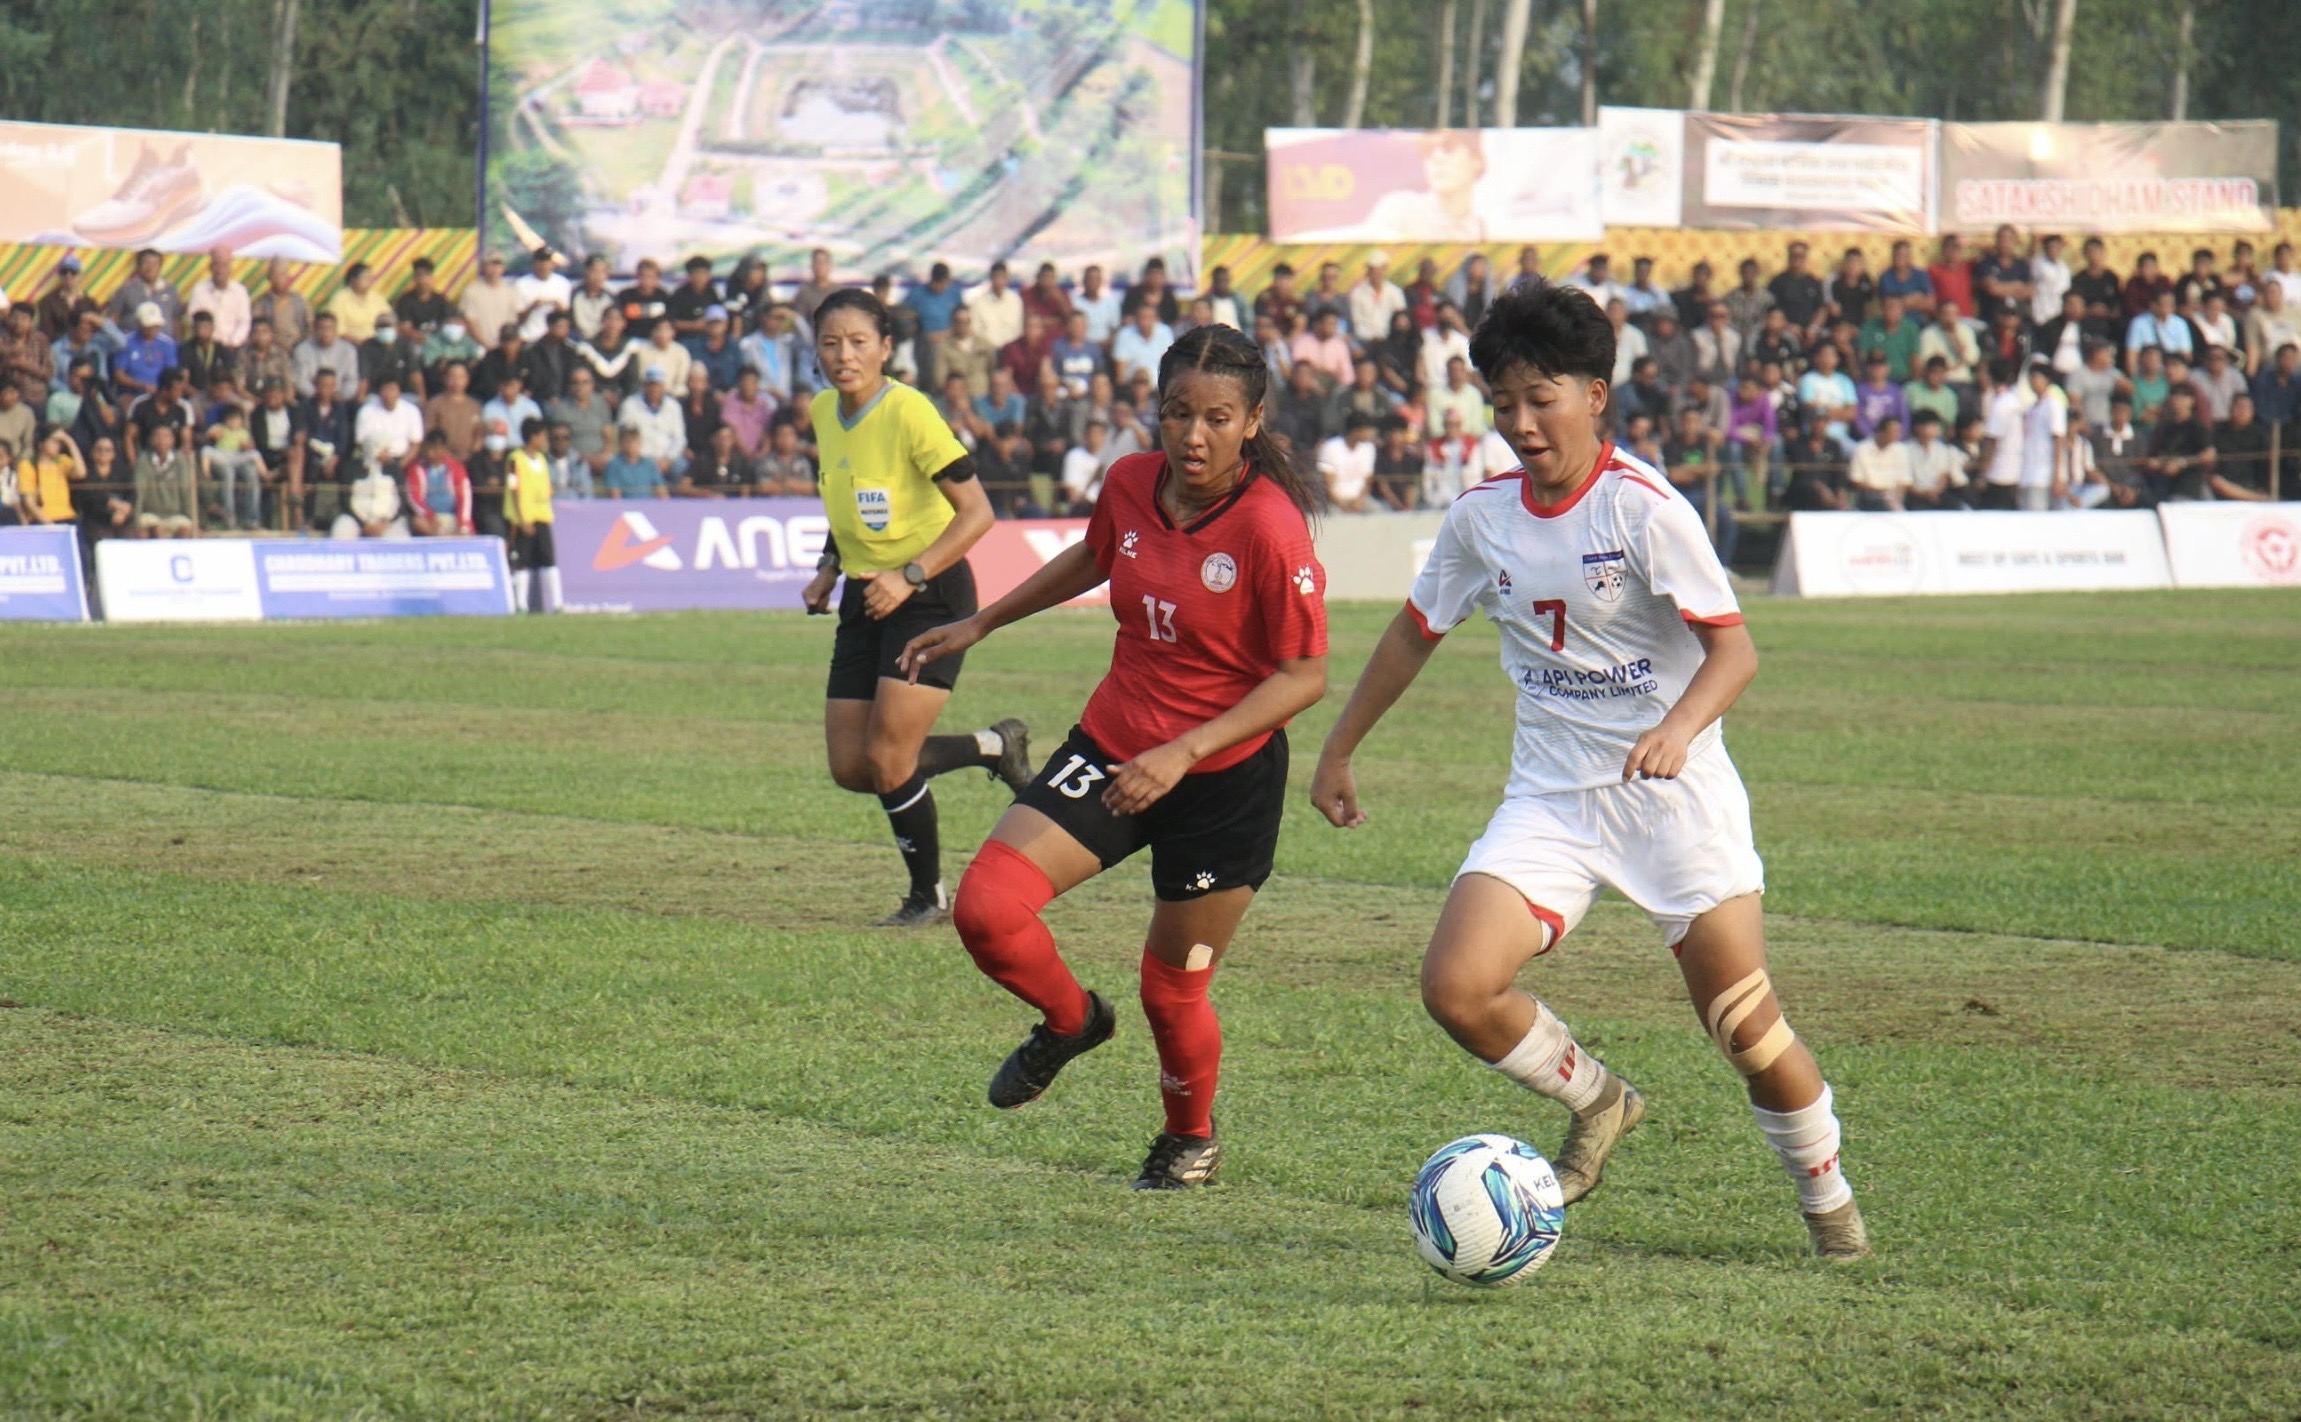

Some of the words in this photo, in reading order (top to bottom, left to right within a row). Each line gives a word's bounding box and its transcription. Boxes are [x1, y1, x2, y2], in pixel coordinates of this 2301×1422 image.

[858, 491, 886, 503] FIFA
[1141, 594, 1178, 643] 13
[1532, 599, 1567, 652] 7
[1542, 669, 1573, 686] API
[1574, 658, 1653, 686] POWER
[1549, 686, 1606, 701] COMPANY
[1610, 679, 1658, 698] LIMITED
[1047, 754, 1105, 798] 13
